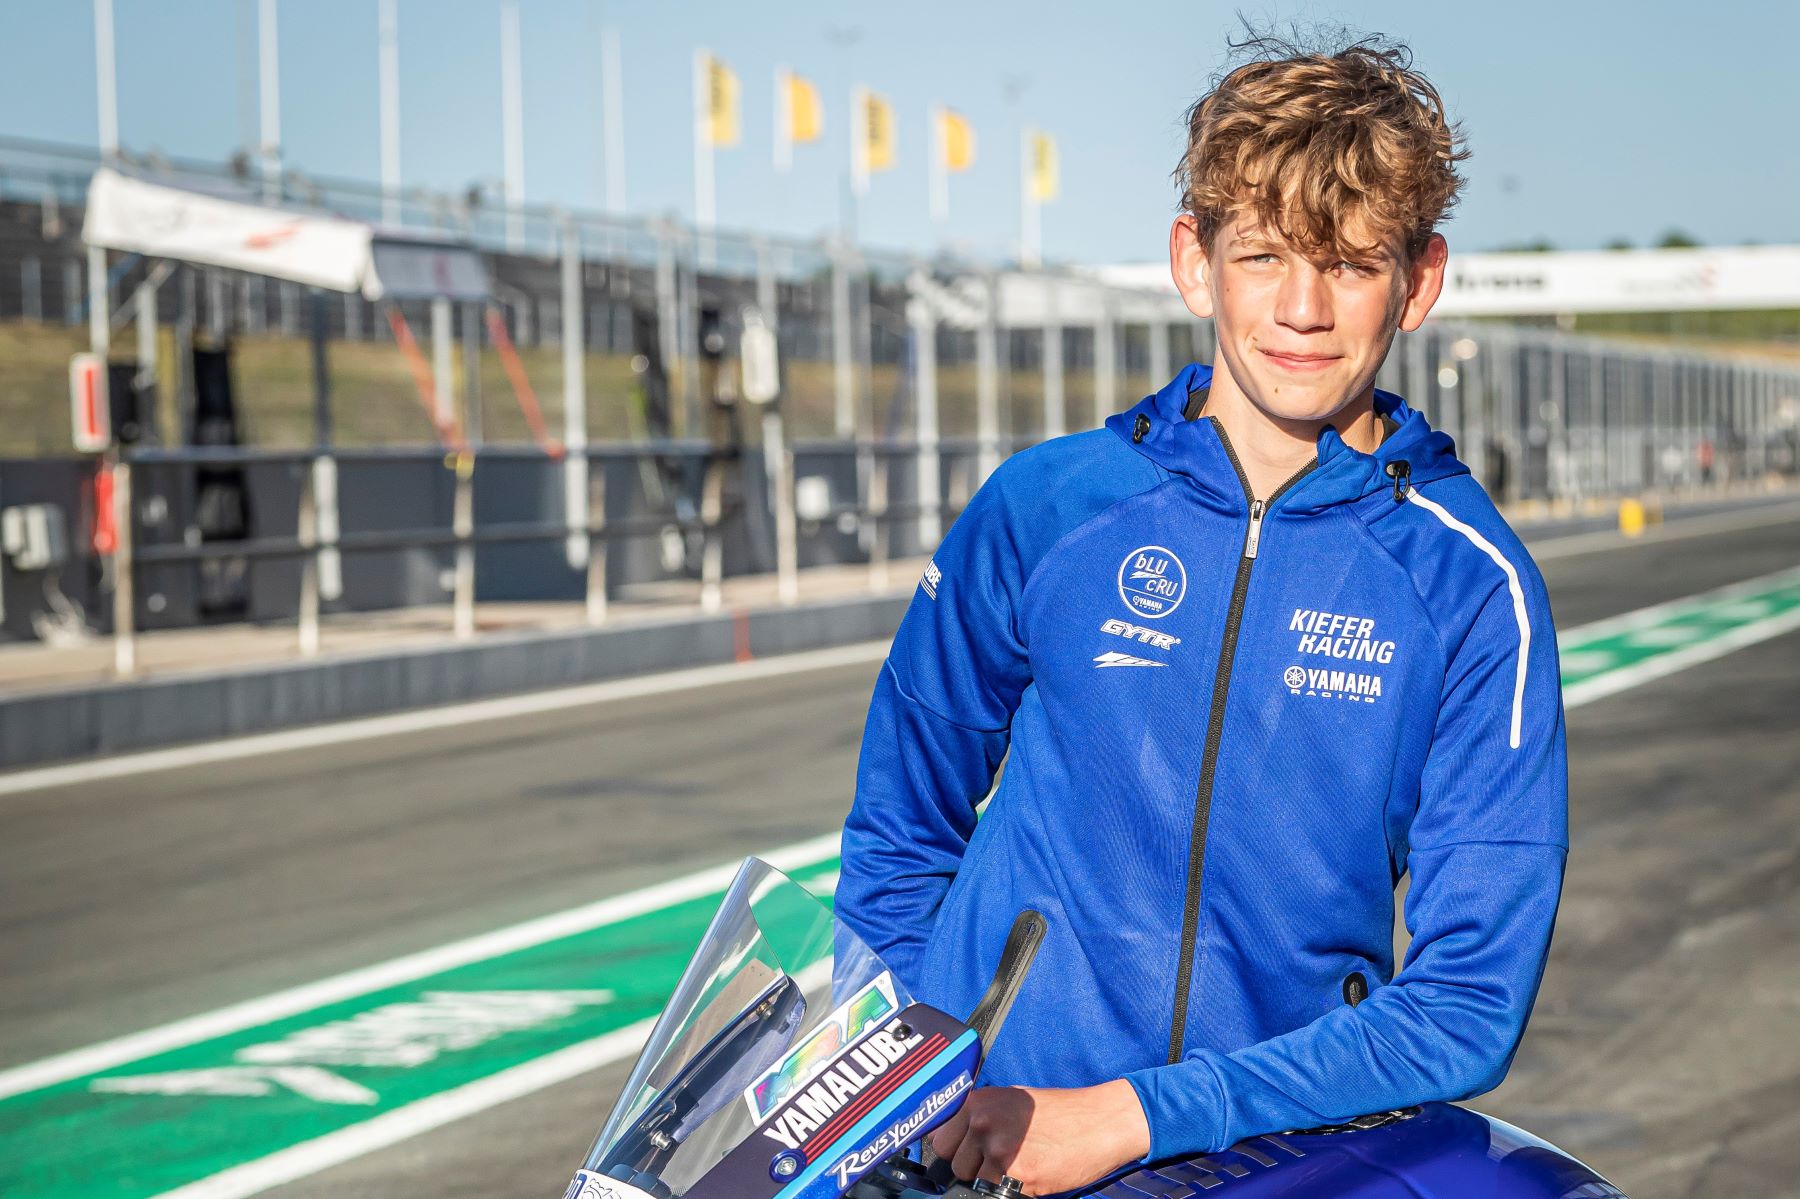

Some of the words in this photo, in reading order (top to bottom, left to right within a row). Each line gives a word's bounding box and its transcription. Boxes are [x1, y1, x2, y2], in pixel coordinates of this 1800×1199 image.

[1288, 608, 1375, 639] KIEFER
[1290, 688, 1376, 704] RACING
[1307, 668, 1382, 697] YAMAHA
[763, 1017, 925, 1150] YAMALUBE
[830, 1134, 888, 1188] Revs
[888, 1107, 926, 1149] Your
[925, 1074, 967, 1115] Heart
